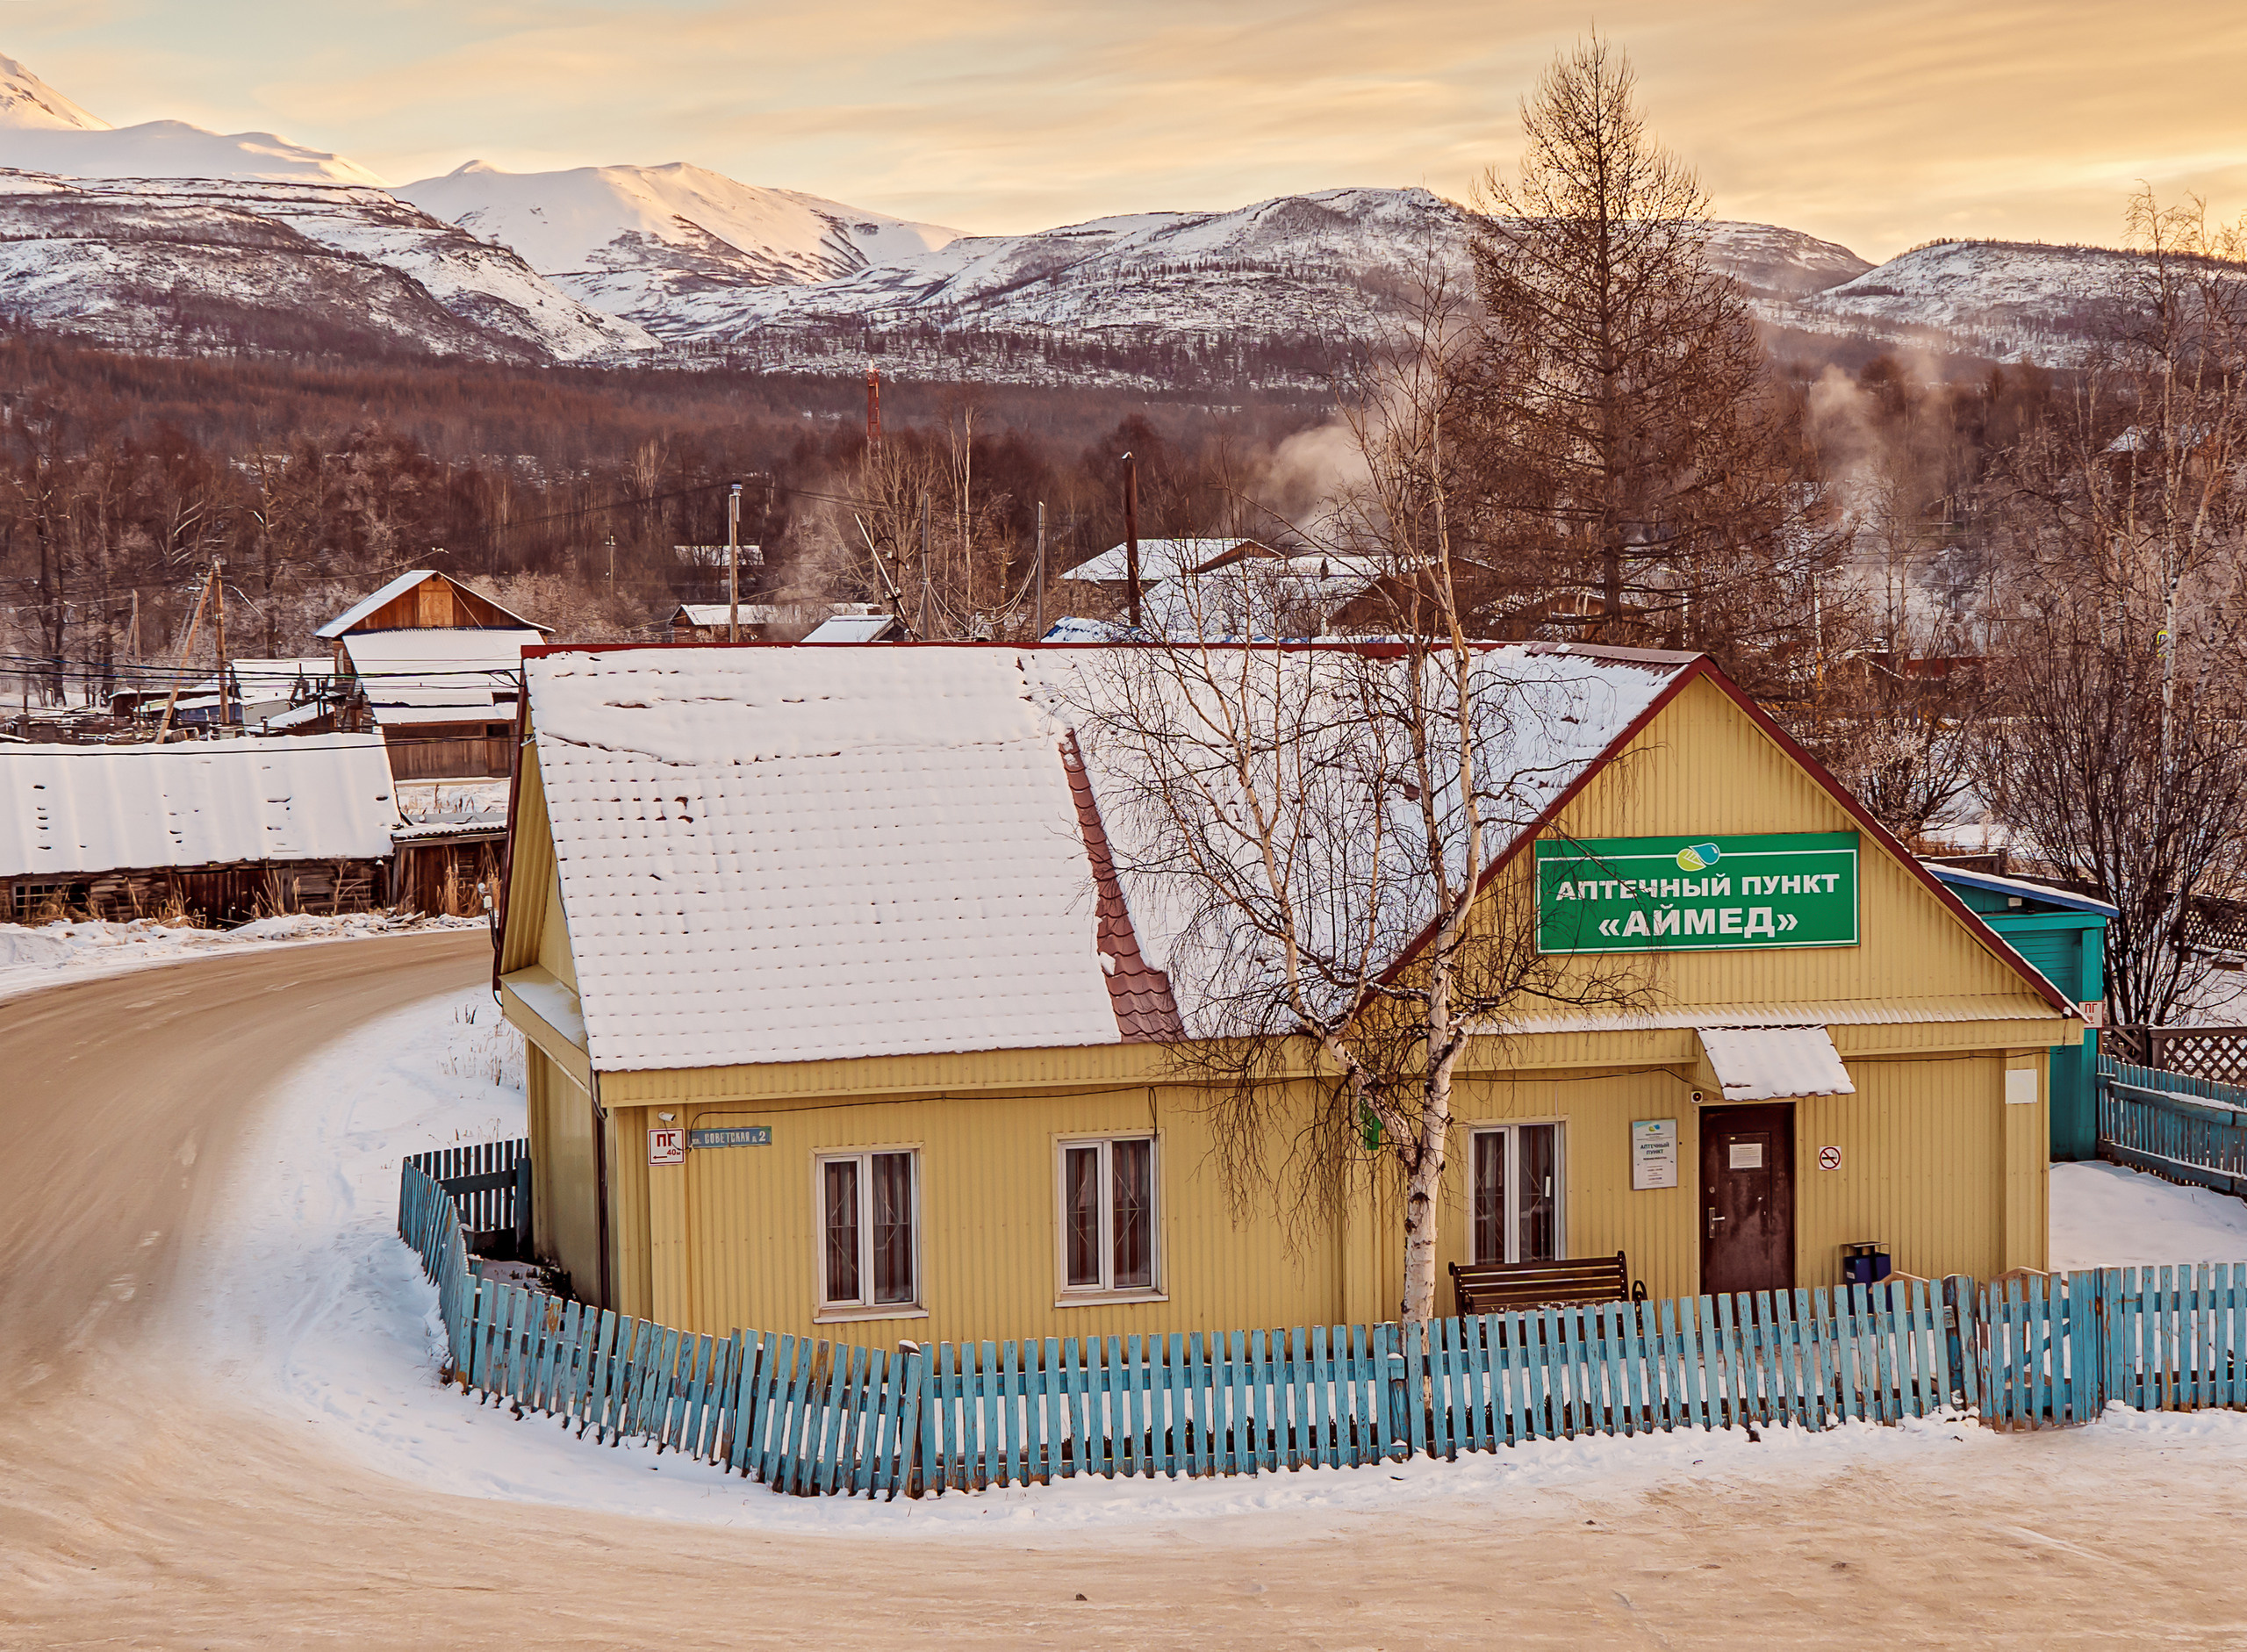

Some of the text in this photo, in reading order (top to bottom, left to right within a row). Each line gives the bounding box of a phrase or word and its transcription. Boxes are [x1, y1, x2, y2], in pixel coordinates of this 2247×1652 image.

[1556, 873, 1841, 901] АПТЕЧНЫЙ ПУНКТ
[1598, 903, 1798, 939] «АЙМЕД»
[2085, 1002, 2098, 1014] ПГ
[657, 1132, 676, 1147] ПГ
[704, 1131, 750, 1144] СОВЕТСКАЯ
[758, 1131, 766, 1142] 2
[1640, 1141, 1669, 1150] АПТЕЧНЫЙ
